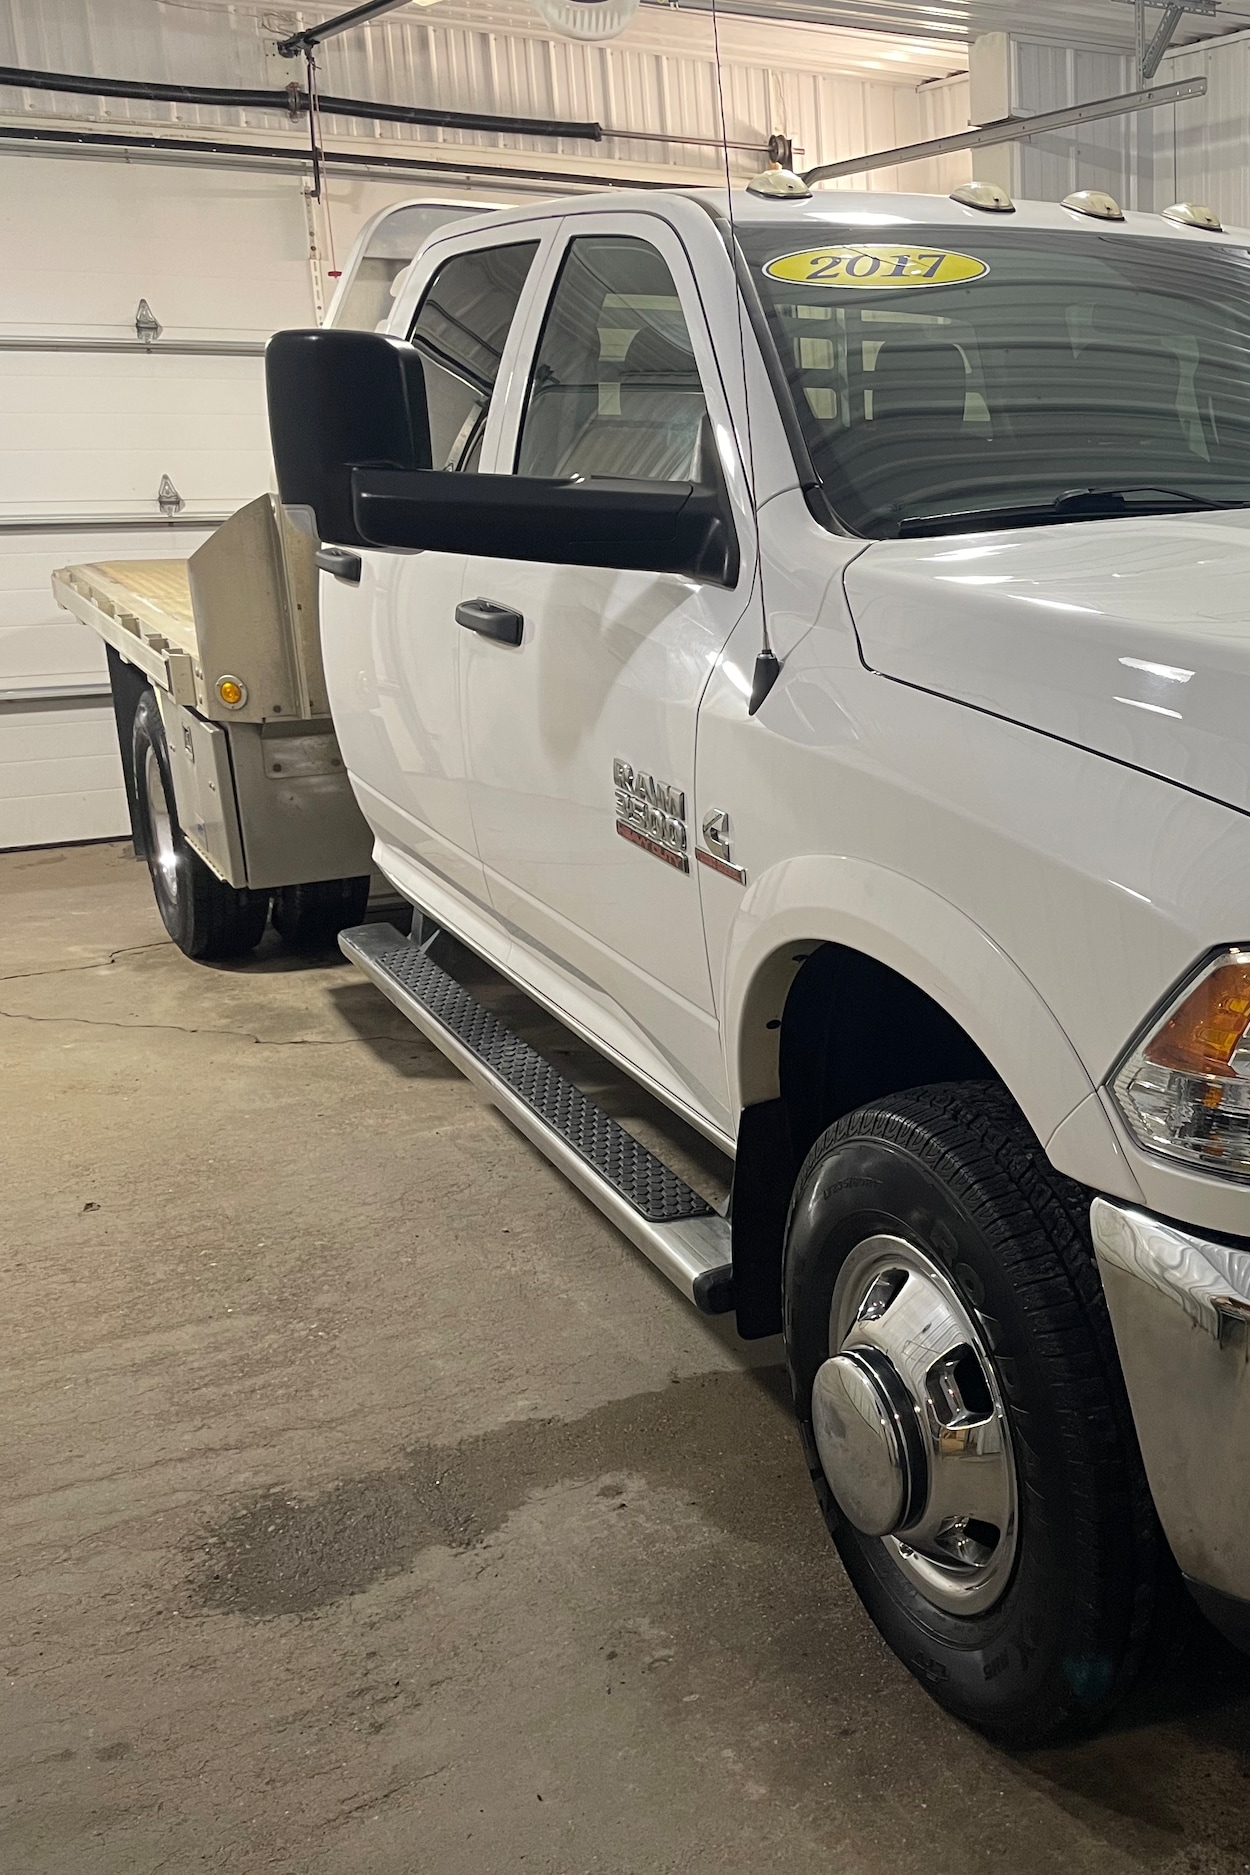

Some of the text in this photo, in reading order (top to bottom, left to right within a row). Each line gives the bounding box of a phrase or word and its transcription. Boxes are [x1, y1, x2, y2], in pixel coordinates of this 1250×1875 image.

[805, 253, 947, 280] 2017
[613, 757, 686, 821] RAM
[614, 788, 687, 852] 3500
